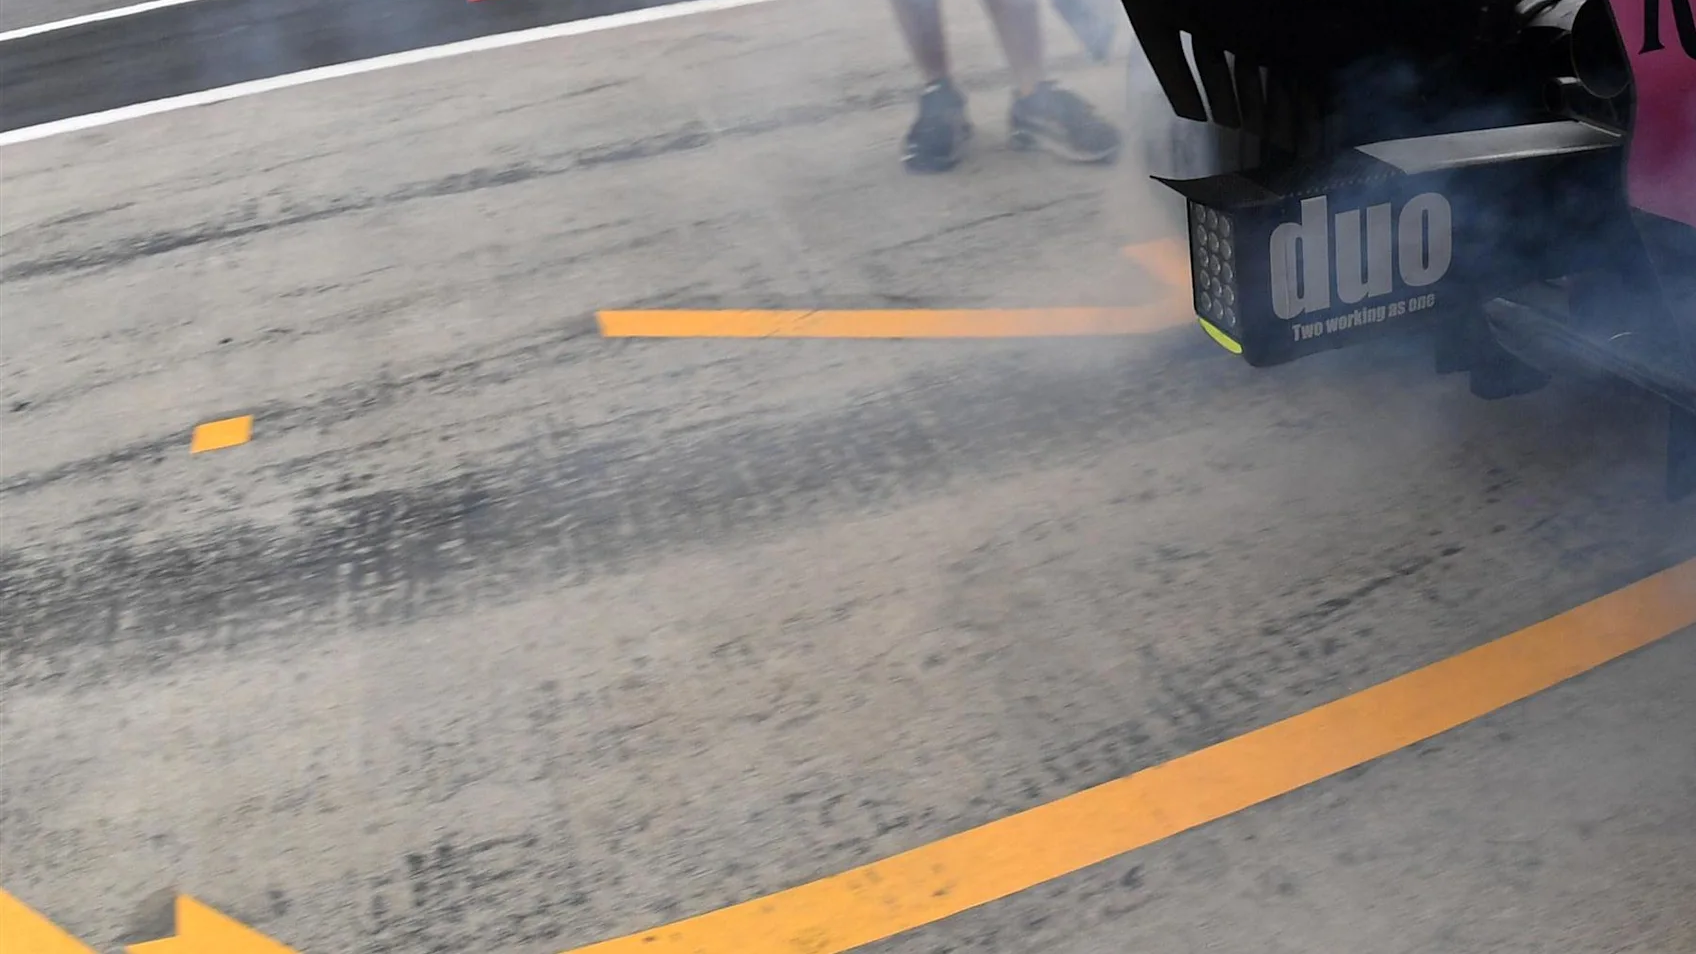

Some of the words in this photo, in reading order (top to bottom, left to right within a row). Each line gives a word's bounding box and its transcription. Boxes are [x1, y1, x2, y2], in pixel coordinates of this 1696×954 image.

[1270, 191, 1452, 320] duo
[1292, 321, 1323, 341] Two
[1326, 304, 1386, 334] working
[1388, 299, 1406, 318] as
[1408, 293, 1436, 312] one
